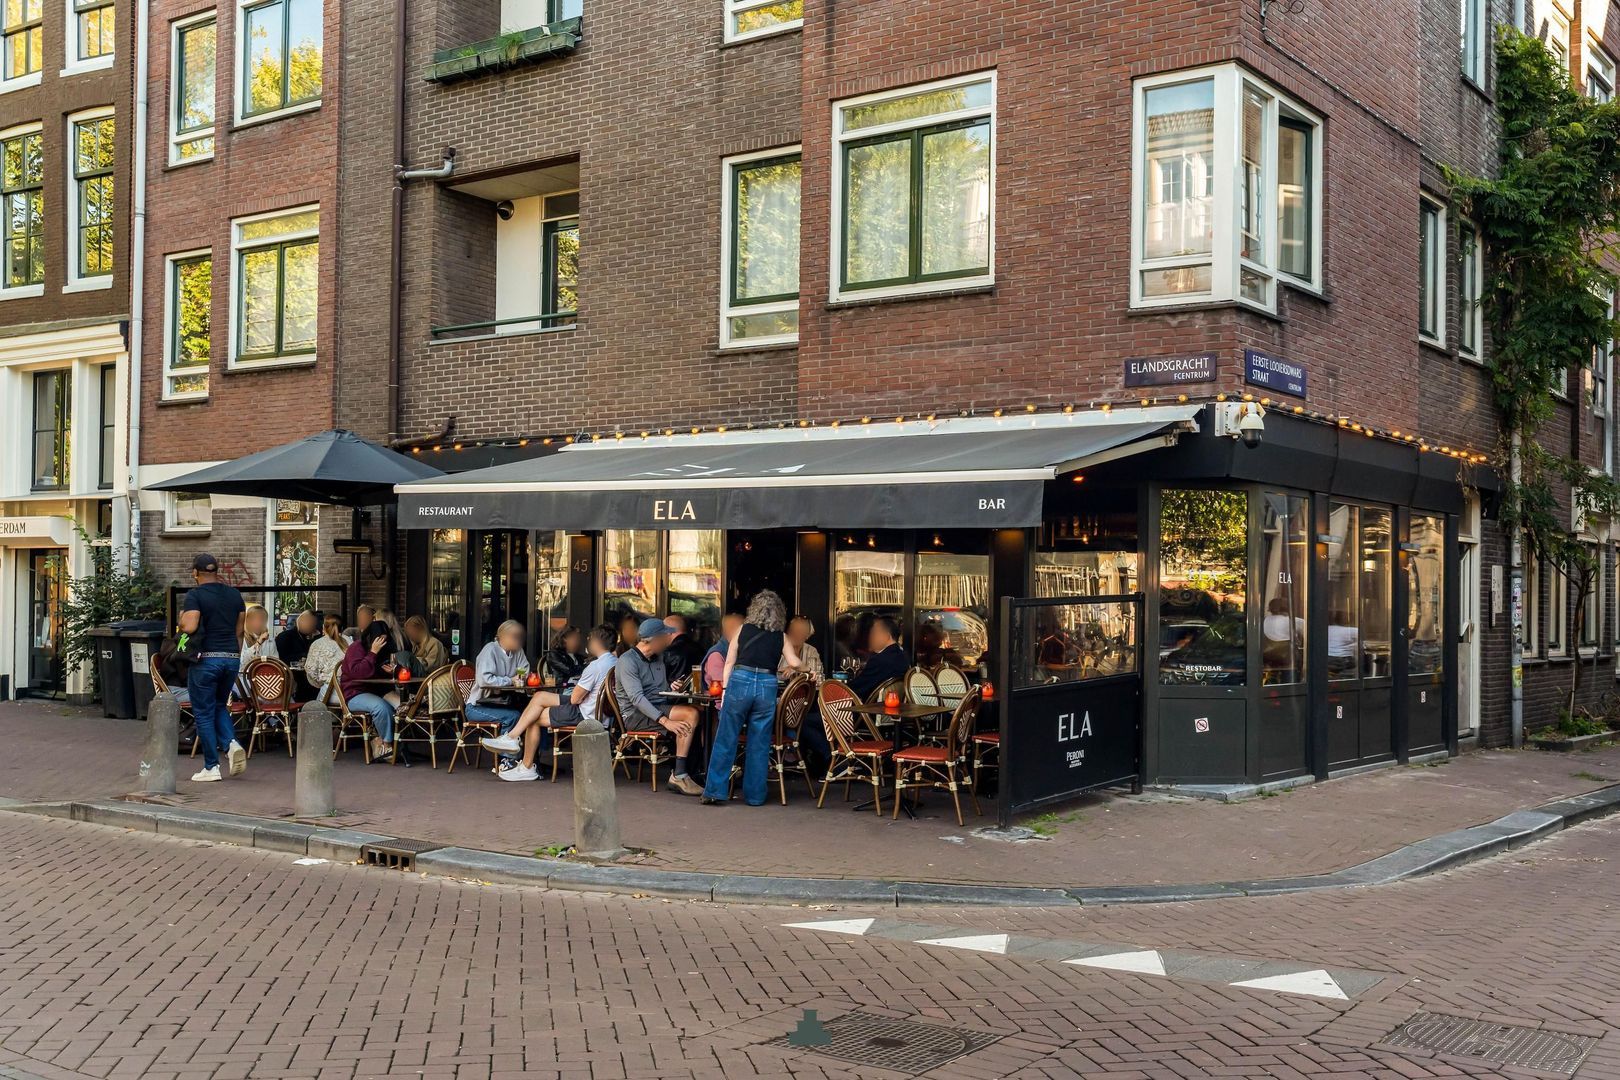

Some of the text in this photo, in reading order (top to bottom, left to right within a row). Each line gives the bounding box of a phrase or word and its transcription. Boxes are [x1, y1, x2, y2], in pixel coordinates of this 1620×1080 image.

[1131, 357, 1209, 374] ELANDSGRACHT
[1252, 355, 1269, 369] EERSTE
[1252, 370, 1269, 383] STRAAT
[653, 500, 696, 521] ELA
[978, 498, 1006, 510] BAR
[418, 506, 474, 516] RESTAURANT
[573, 559, 588, 572] 45
[1279, 572, 1292, 584] ELA
[1058, 710, 1093, 742] ELA
[1066, 749, 1085, 761] PERONI
